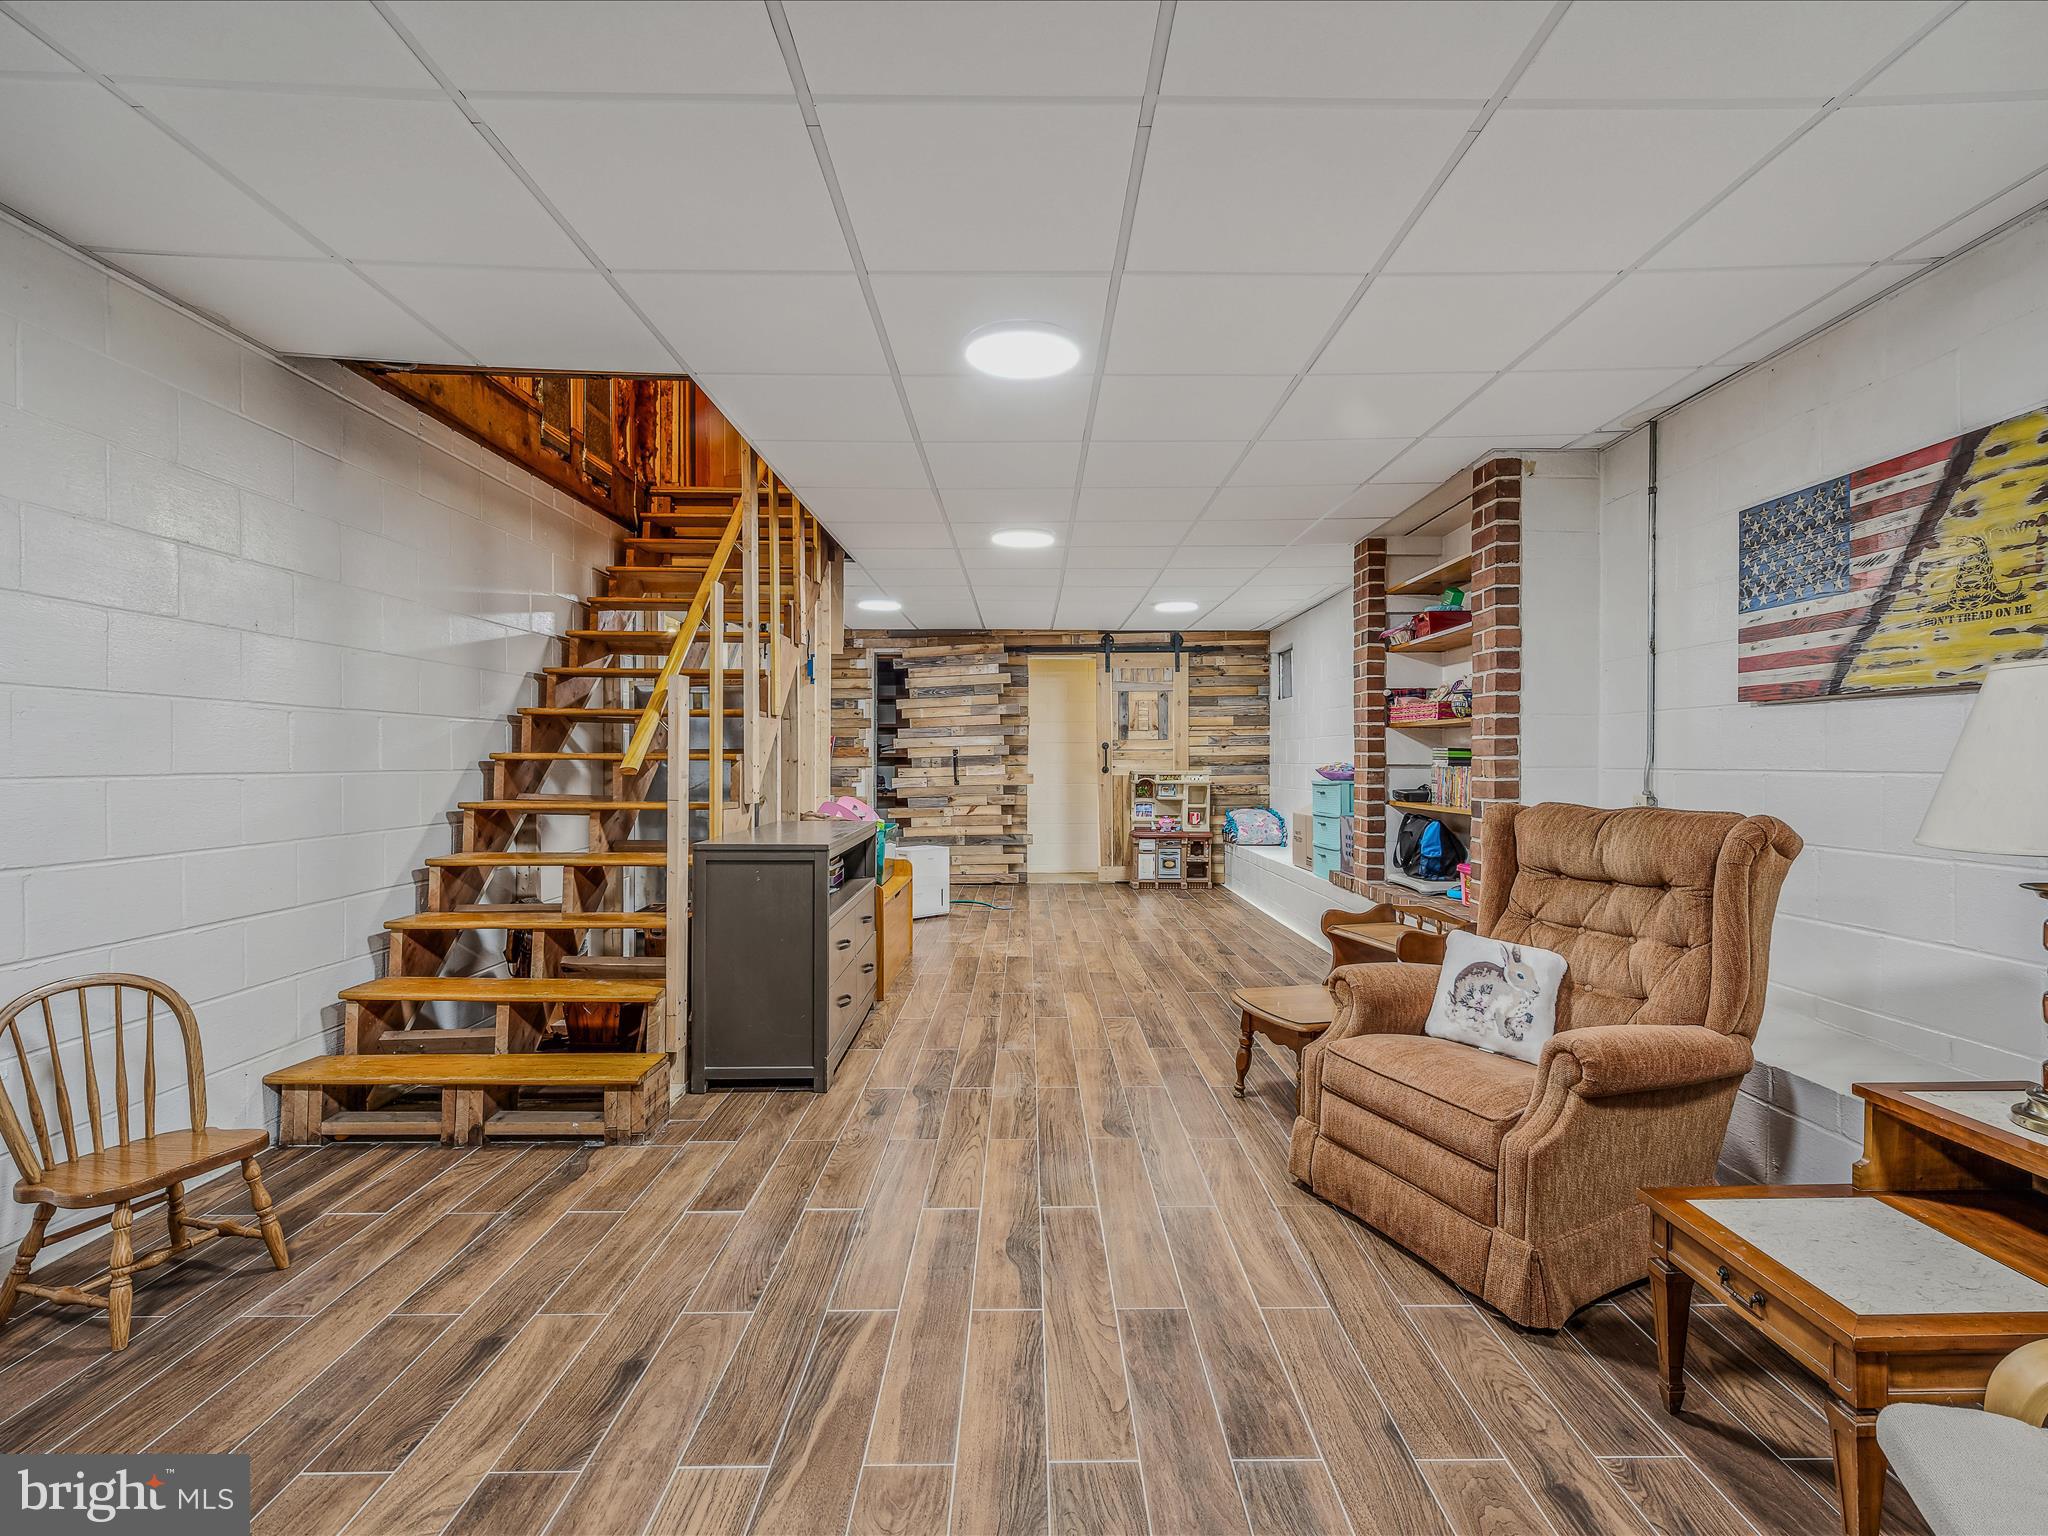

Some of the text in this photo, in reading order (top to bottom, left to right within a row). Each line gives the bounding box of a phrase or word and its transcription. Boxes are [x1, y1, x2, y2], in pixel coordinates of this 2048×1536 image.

[1924, 604, 2033, 627] DON'T TREAD ON ME
